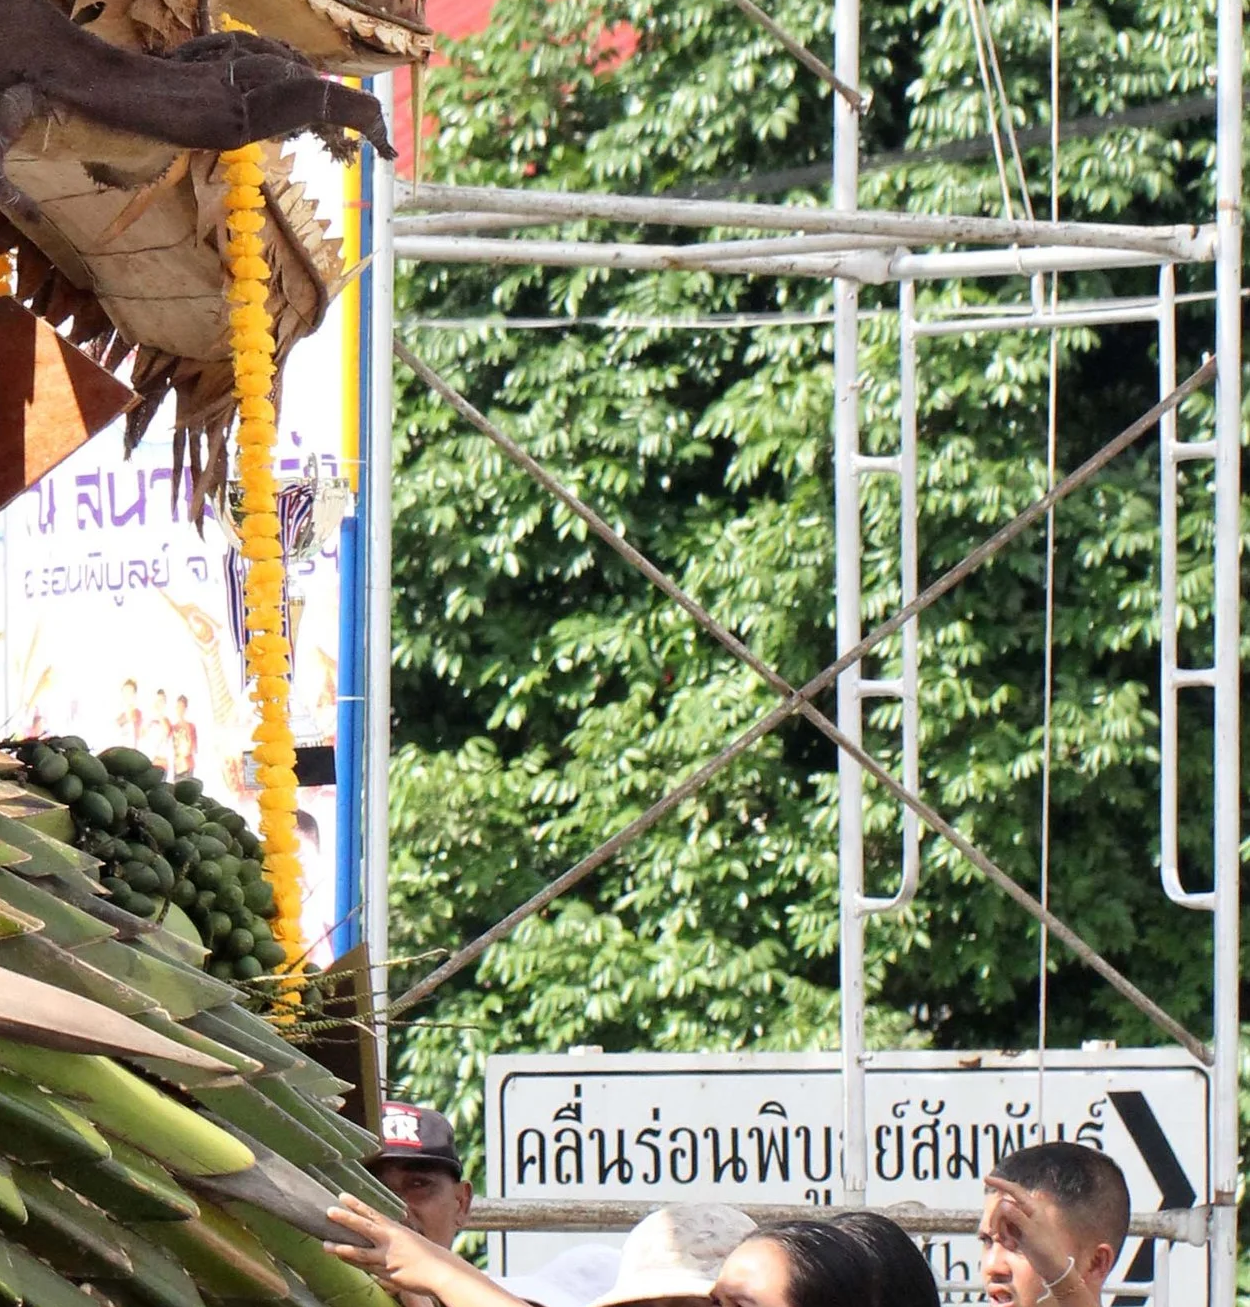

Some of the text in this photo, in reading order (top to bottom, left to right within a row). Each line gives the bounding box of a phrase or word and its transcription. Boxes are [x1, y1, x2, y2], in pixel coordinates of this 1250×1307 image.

[516, 1083, 1107, 1206] คลื่นร่อนพิบูย์สัมพัธ์
